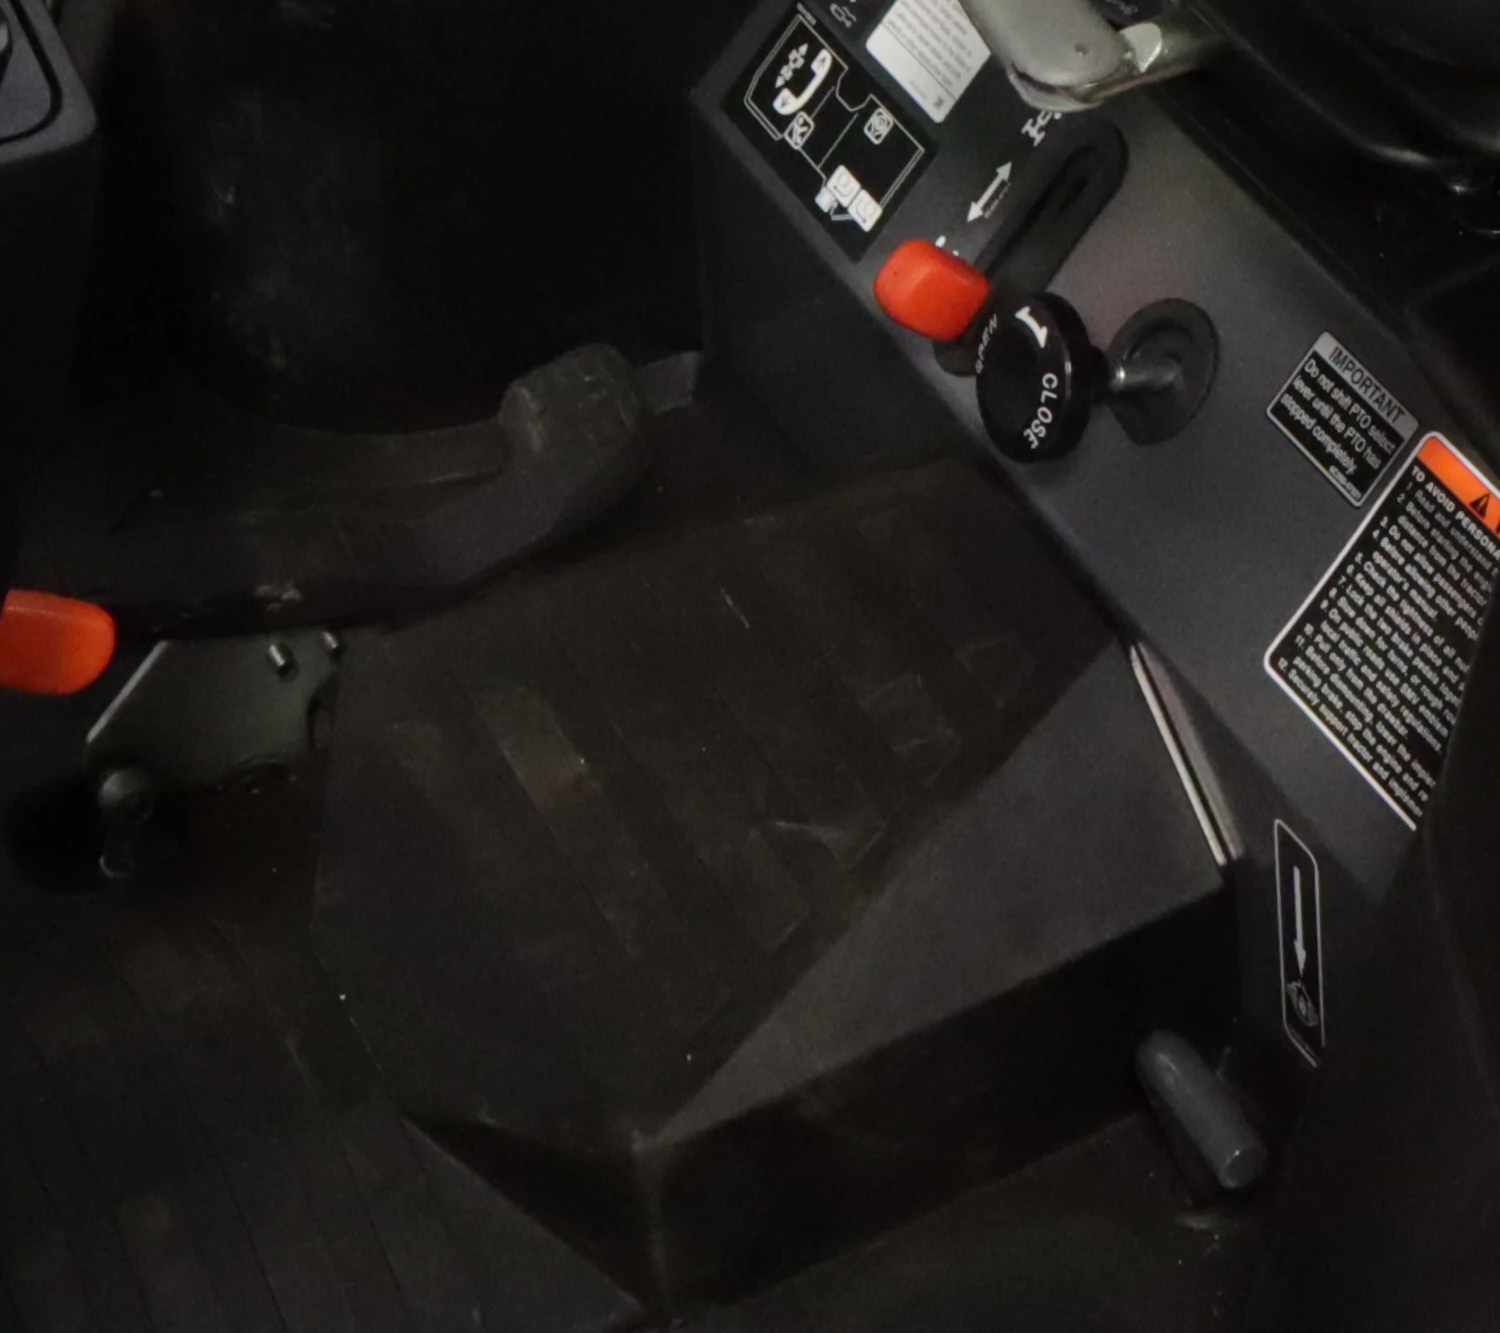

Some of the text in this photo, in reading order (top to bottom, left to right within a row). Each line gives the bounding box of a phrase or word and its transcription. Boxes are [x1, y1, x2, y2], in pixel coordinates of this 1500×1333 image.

[975, 314, 998, 374] OPEN
[1326, 345, 1406, 426] IMPORTANT
[1023, 373, 1058, 449] CLOSE
[1277, 388, 1318, 434] stopped
[1290, 373, 1318, 403] lever
[1310, 392, 1335, 420] until
[1327, 410, 1348, 435] the
[1341, 424, 1369, 455] PTO
[1361, 444, 1385, 471] has
[1302, 357, 1397, 455] Do not shift PTO select
[1408, 463, 1427, 485] TO
[1422, 478, 1457, 515] AVOID
[1412, 488, 1436, 514] Read
[1432, 507, 1452, 529] and
[1447, 524, 1493, 572] understand
[1378, 534, 1407, 567] Before
[1401, 559, 1437, 601] allowing
[1433, 592, 1457, 620] other
[1386, 522, 1403, 542] Do
[1398, 536, 1416, 556] not
[1412, 549, 1436, 577] allow
[1431, 570, 1478, 623] passengers
[1395, 511, 1431, 550] distance
[1426, 542, 1449, 569] from
[1445, 561, 1462, 583] the
[1403, 499, 1432, 531] Before
[1427, 525, 1461, 563] starting
[1457, 553, 1474, 575] the
[1326, 605, 1343, 626] On
[1337, 618, 1365, 651] public
[1361, 641, 1387, 672] roads
[1382, 664, 1401, 688] use
[1335, 594, 1358, 621] Slow
[1353, 613, 1377, 642] down
[1373, 633, 1390, 655] for
[1408, 670, 1422, 690] or
[1417, 681, 1444, 715] rough
[1343, 582, 1366, 608] Lock
[1361, 601, 1379, 623] the
[1375, 615, 1393, 638] two
[1389, 629, 1415, 661] brake
[1411, 652, 1440, 688] pedals
[1351, 570, 1376, 600] Keep
[1371, 590, 1387, 610] all
[1382, 601, 1413, 638] shields
[1409, 630, 1422, 647] in
[1418, 638, 1443, 671] place
[1440, 661, 1459, 687] and
[1361, 558, 1388, 589] Check
[1384, 582, 1402, 604] the
[1396, 596, 1435, 641] tightness
[1431, 630, 1445, 651] of
[1441, 640, 1456, 662] all
[1303, 644, 1332, 677] Before
[1374, 718, 1398, 750] lower
[1395, 741, 1412, 765] the
[1312, 632, 1332, 656] Pull
[1326, 648, 1348, 675] only
[1344, 666, 1365, 692] from
[1362, 684, 1379, 707] the
[1318, 618, 1341, 645] local
[1336, 637, 1363, 668] traffic
[1358, 660, 1378, 685] and
[1373, 676, 1401, 712] safety
[1285, 666, 1321, 710] Securely
[1316, 700, 1349, 740] support
[1345, 730, 1374, 766] tractor
[1370, 757, 1389, 784] and
[1291, 652, 1323, 690] parking
[1342, 707, 1364, 736] stop
[1360, 725, 1378, 749] the
[1373, 740, 1403, 778] engine
[1400, 769, 1419, 795] and
